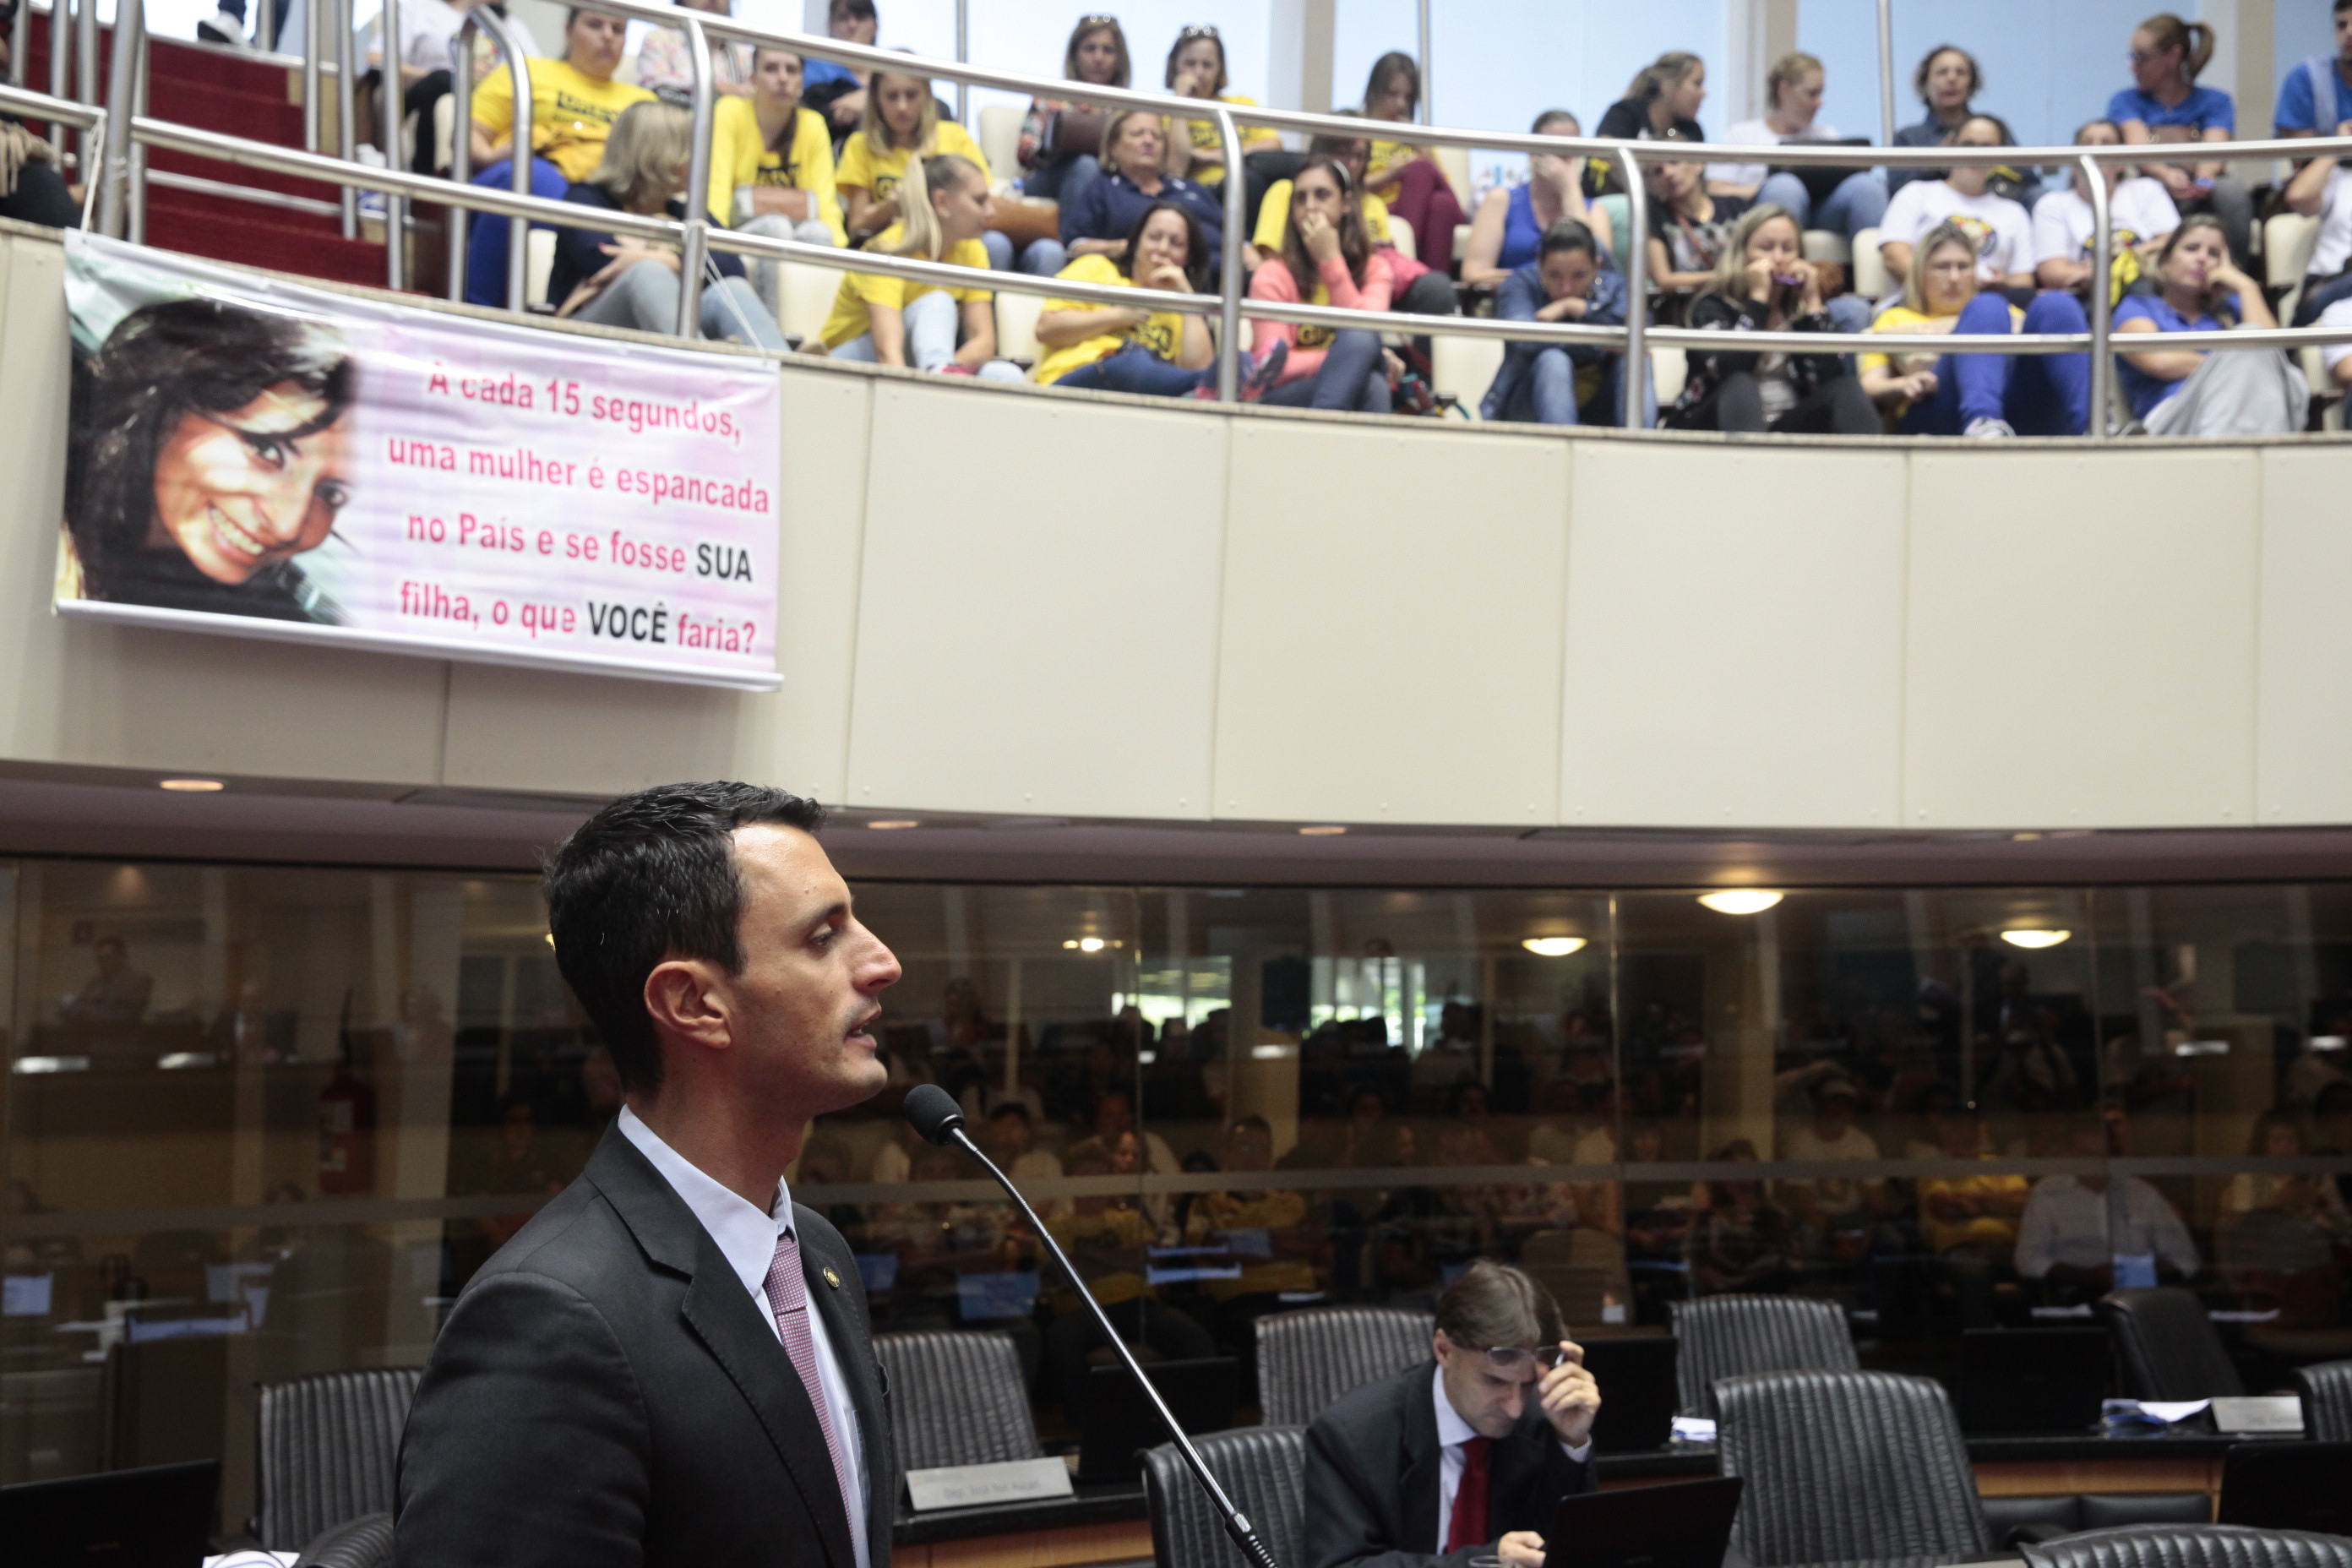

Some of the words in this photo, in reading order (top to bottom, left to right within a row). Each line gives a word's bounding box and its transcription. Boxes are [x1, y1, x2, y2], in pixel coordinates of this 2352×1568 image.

[460, 371, 533, 409] cada
[547, 377, 581, 416] 15
[592, 397, 741, 446] segundos,
[389, 435, 456, 471] uma
[469, 448, 578, 487] mulher
[588, 456, 605, 490] é
[617, 468, 770, 514] espancada
[407, 514, 446, 544] no
[536, 530, 555, 556] e
[565, 532, 601, 562] se
[611, 529, 686, 574] fosse
[696, 542, 753, 582] SUA
[401, 580, 481, 630] filha,
[492, 600, 510, 626] o
[520, 602, 577, 639] que
[587, 599, 669, 645] VOCÊ
[677, 612, 756, 655] faria?
